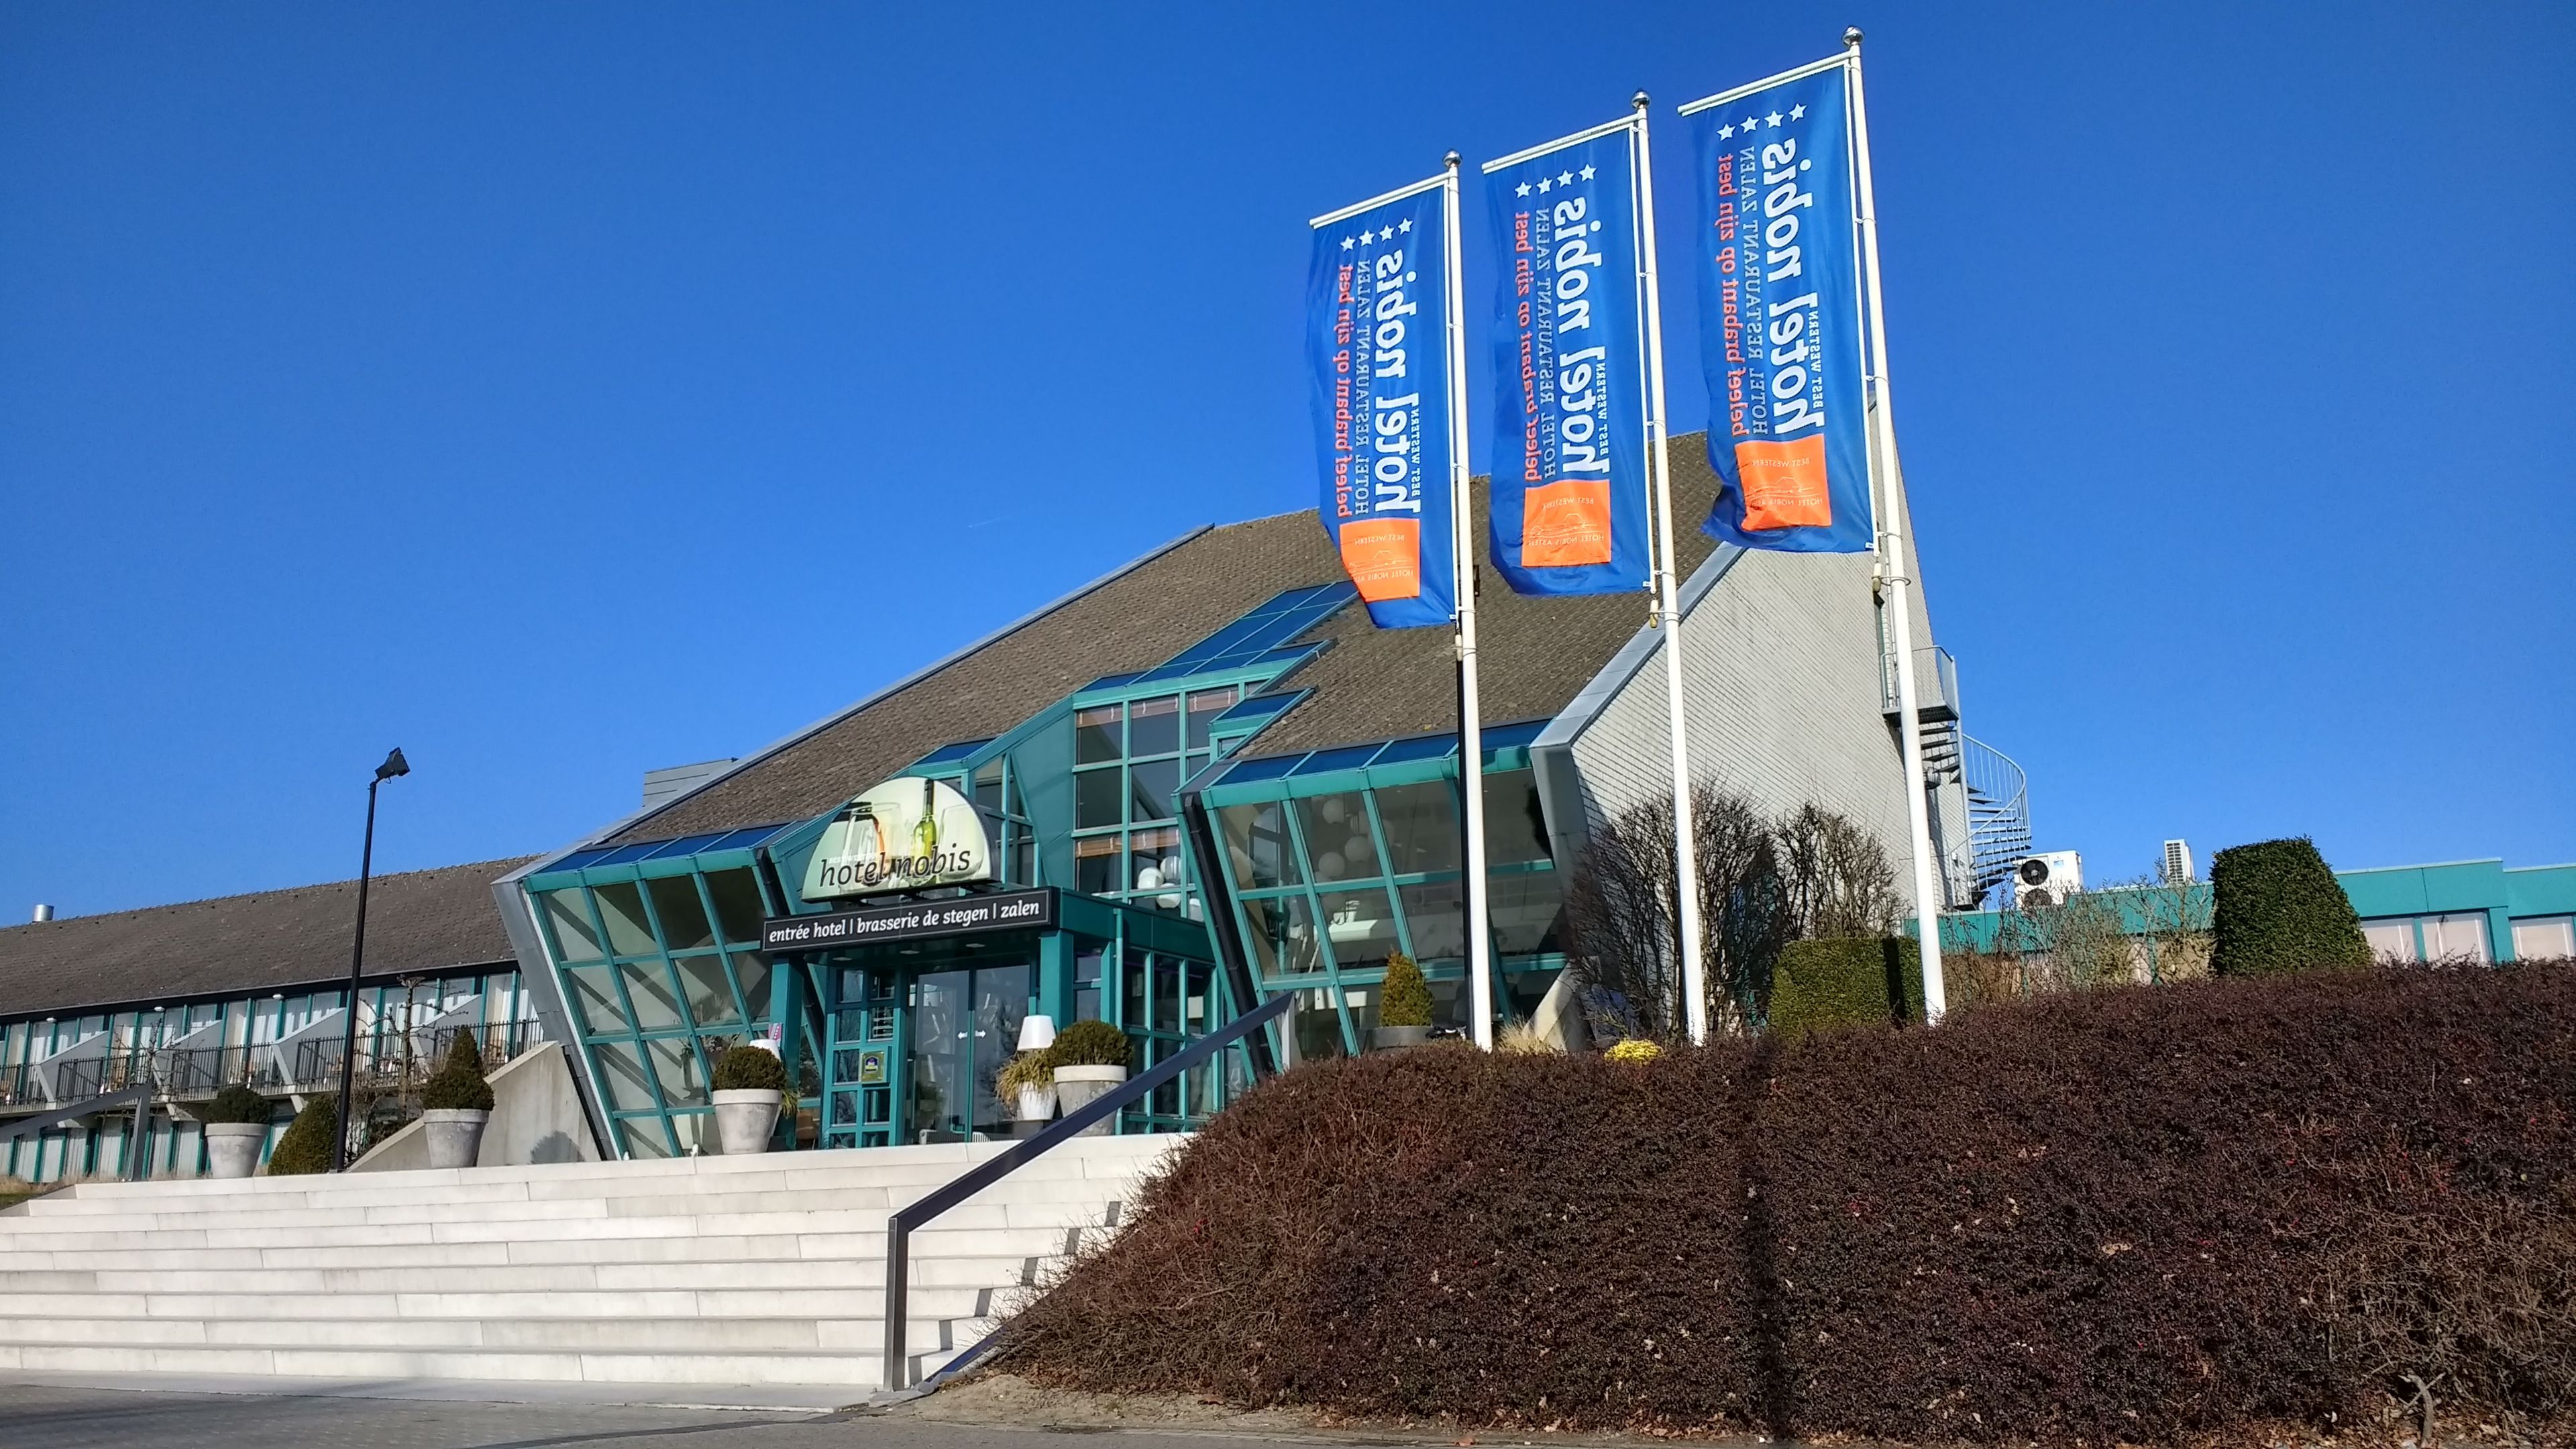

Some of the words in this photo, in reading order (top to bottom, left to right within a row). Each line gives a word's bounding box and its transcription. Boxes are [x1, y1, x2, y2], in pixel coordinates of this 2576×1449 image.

[819, 851, 886, 887] hotel
[896, 843, 971, 878] nobis
[769, 924, 810, 943] entrée
[813, 919, 845, 938] hotel
[857, 912, 919, 934] brasserie
[922, 910, 939, 926] de
[943, 907, 989, 927] stegen
[1000, 900, 1040, 918] zalen
